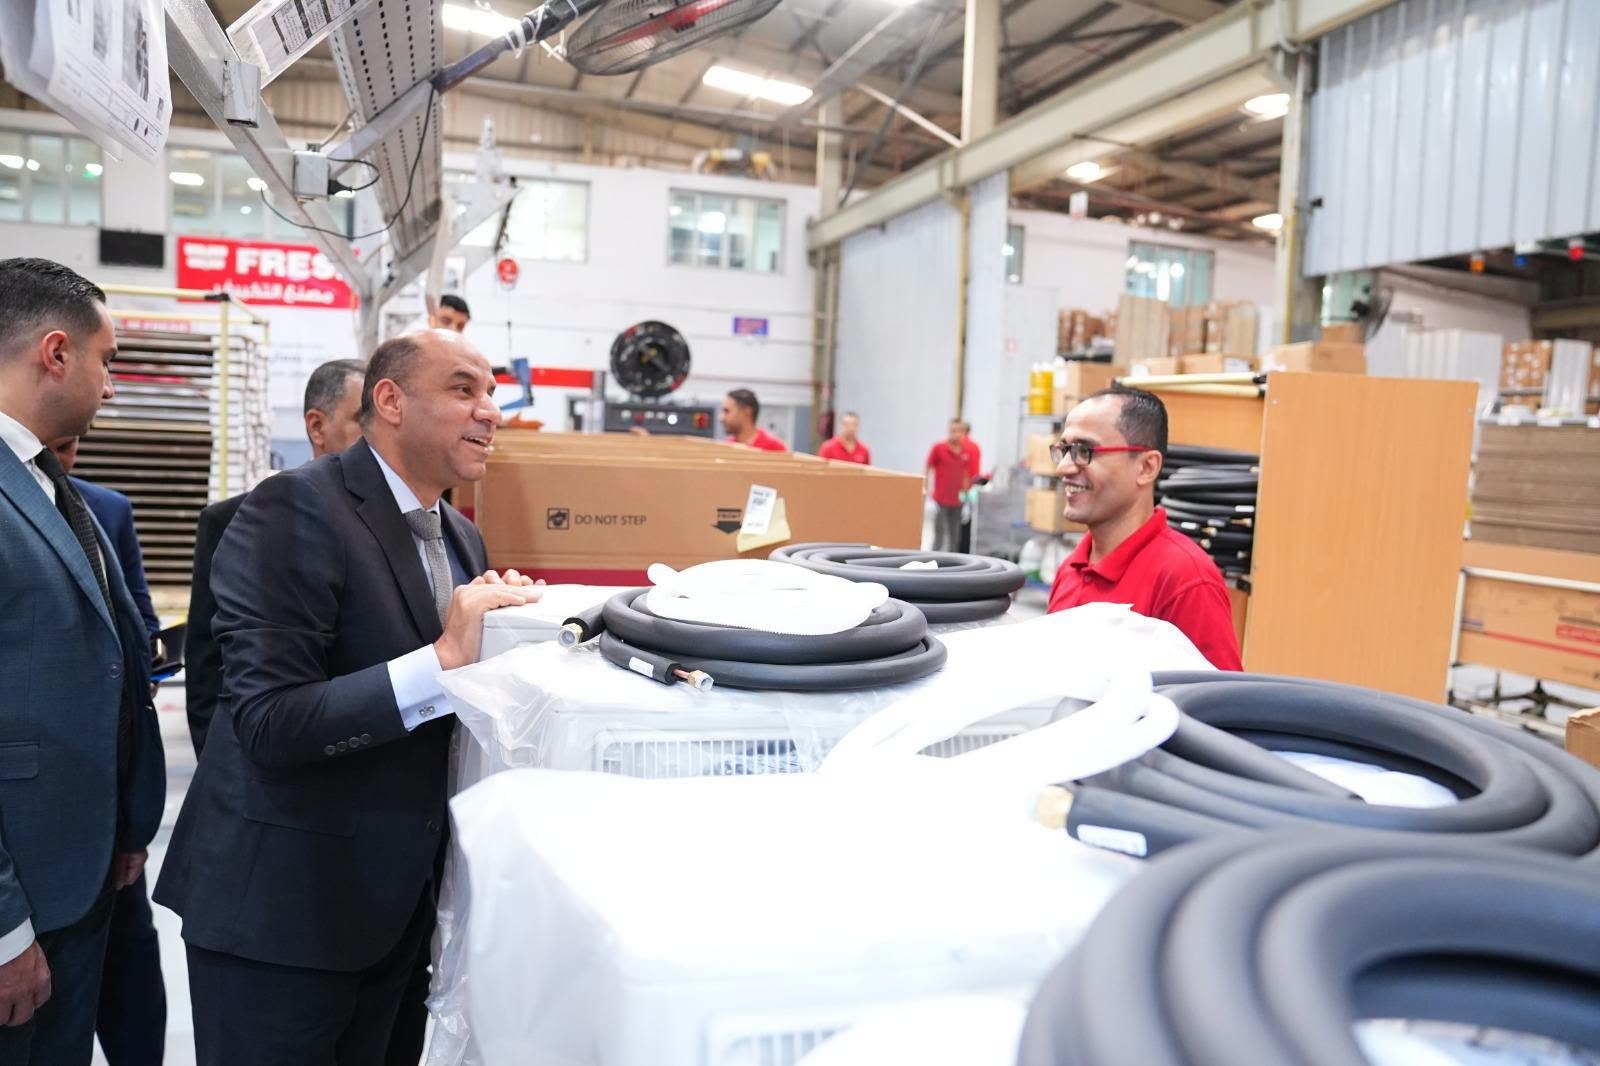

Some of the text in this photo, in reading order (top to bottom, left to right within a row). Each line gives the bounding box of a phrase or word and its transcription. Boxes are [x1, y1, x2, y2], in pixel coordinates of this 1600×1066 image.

[236, 247, 343, 281] FRES
[575, 514, 647, 526] DO NOT STEP
